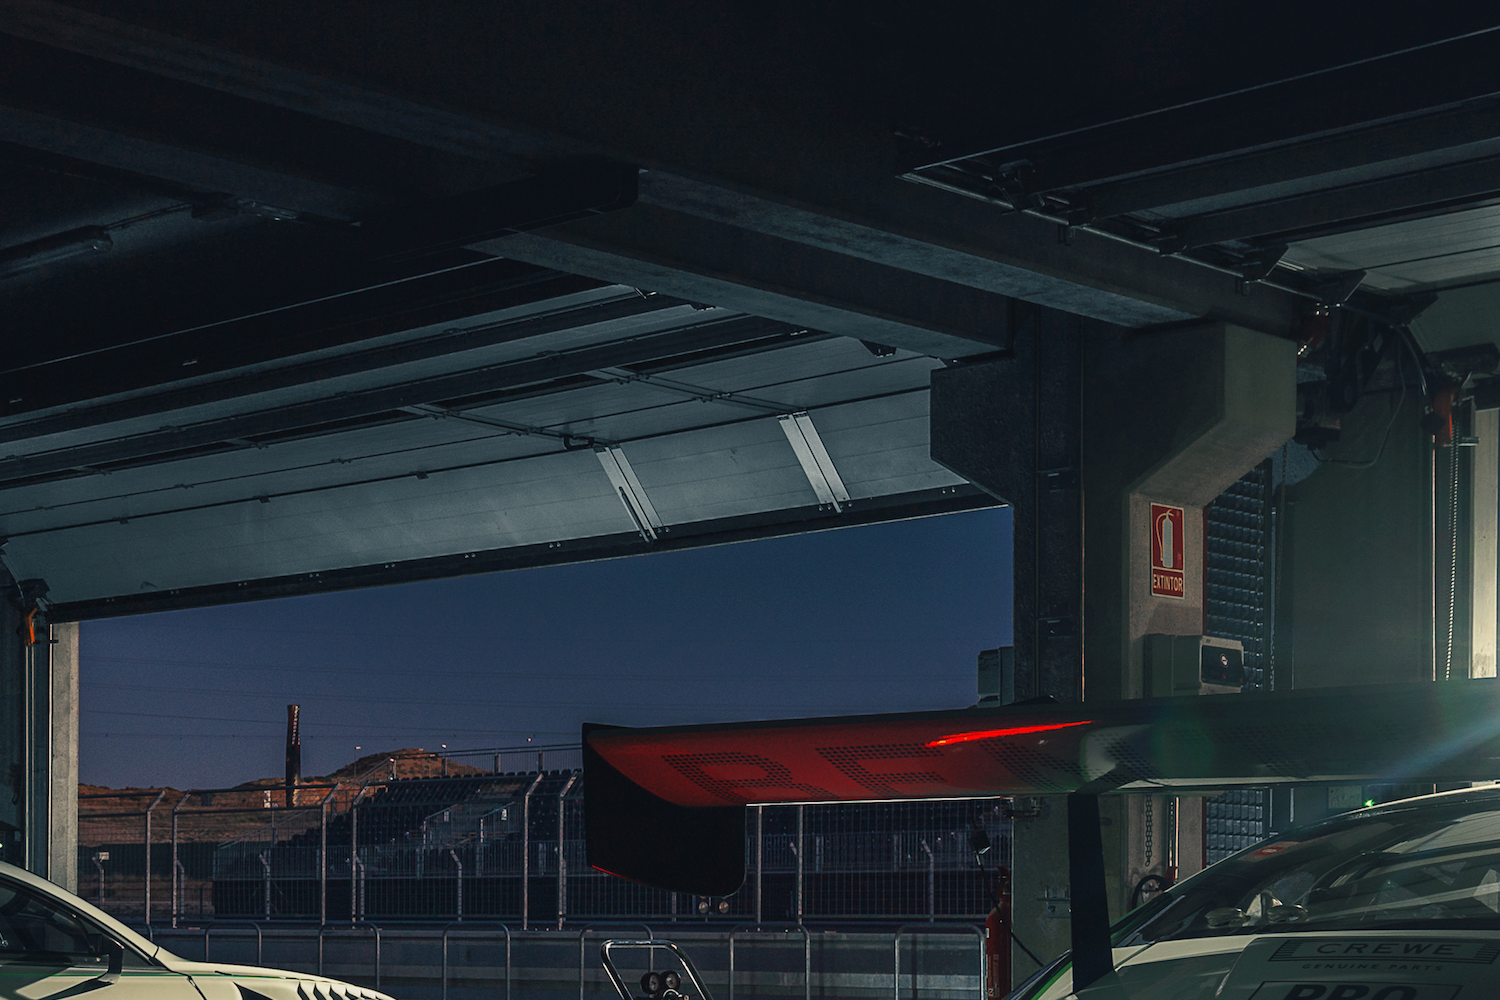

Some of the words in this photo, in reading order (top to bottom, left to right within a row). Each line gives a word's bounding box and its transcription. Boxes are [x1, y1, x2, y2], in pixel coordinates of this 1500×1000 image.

[1153, 574, 1184, 592] EXTINTOR
[1316, 942, 1461, 956] CREWE
[1389, 963, 1444, 972] PARTS
